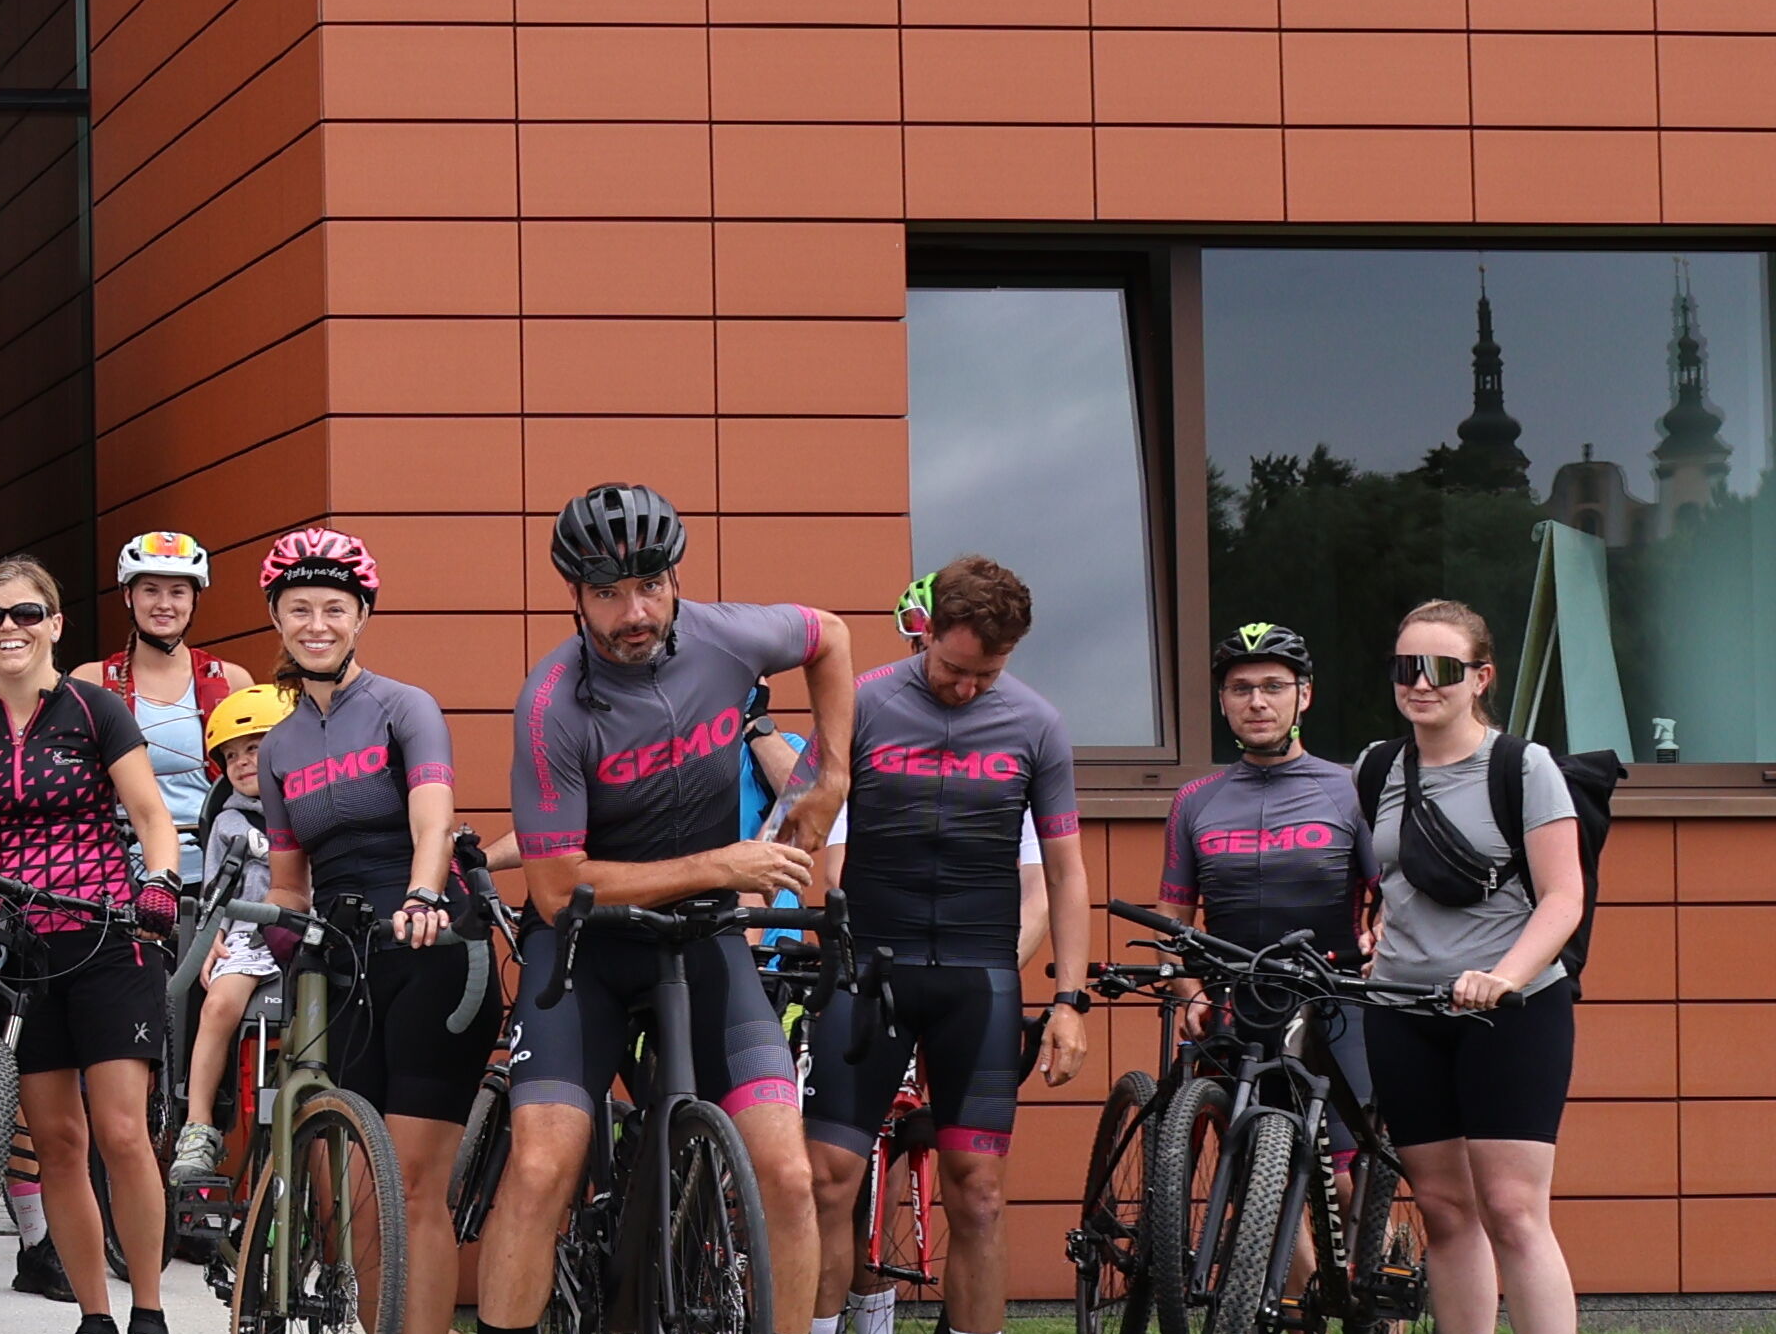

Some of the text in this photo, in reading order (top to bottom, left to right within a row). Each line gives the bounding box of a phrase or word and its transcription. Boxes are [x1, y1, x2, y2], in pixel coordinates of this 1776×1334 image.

[527, 662, 567, 813] #gemocyclingteam
[597, 706, 741, 785] GEMO
[871, 744, 1020, 782] GEMO
[283, 745, 389, 800] GEMO
[1199, 822, 1333, 856] GEMO
